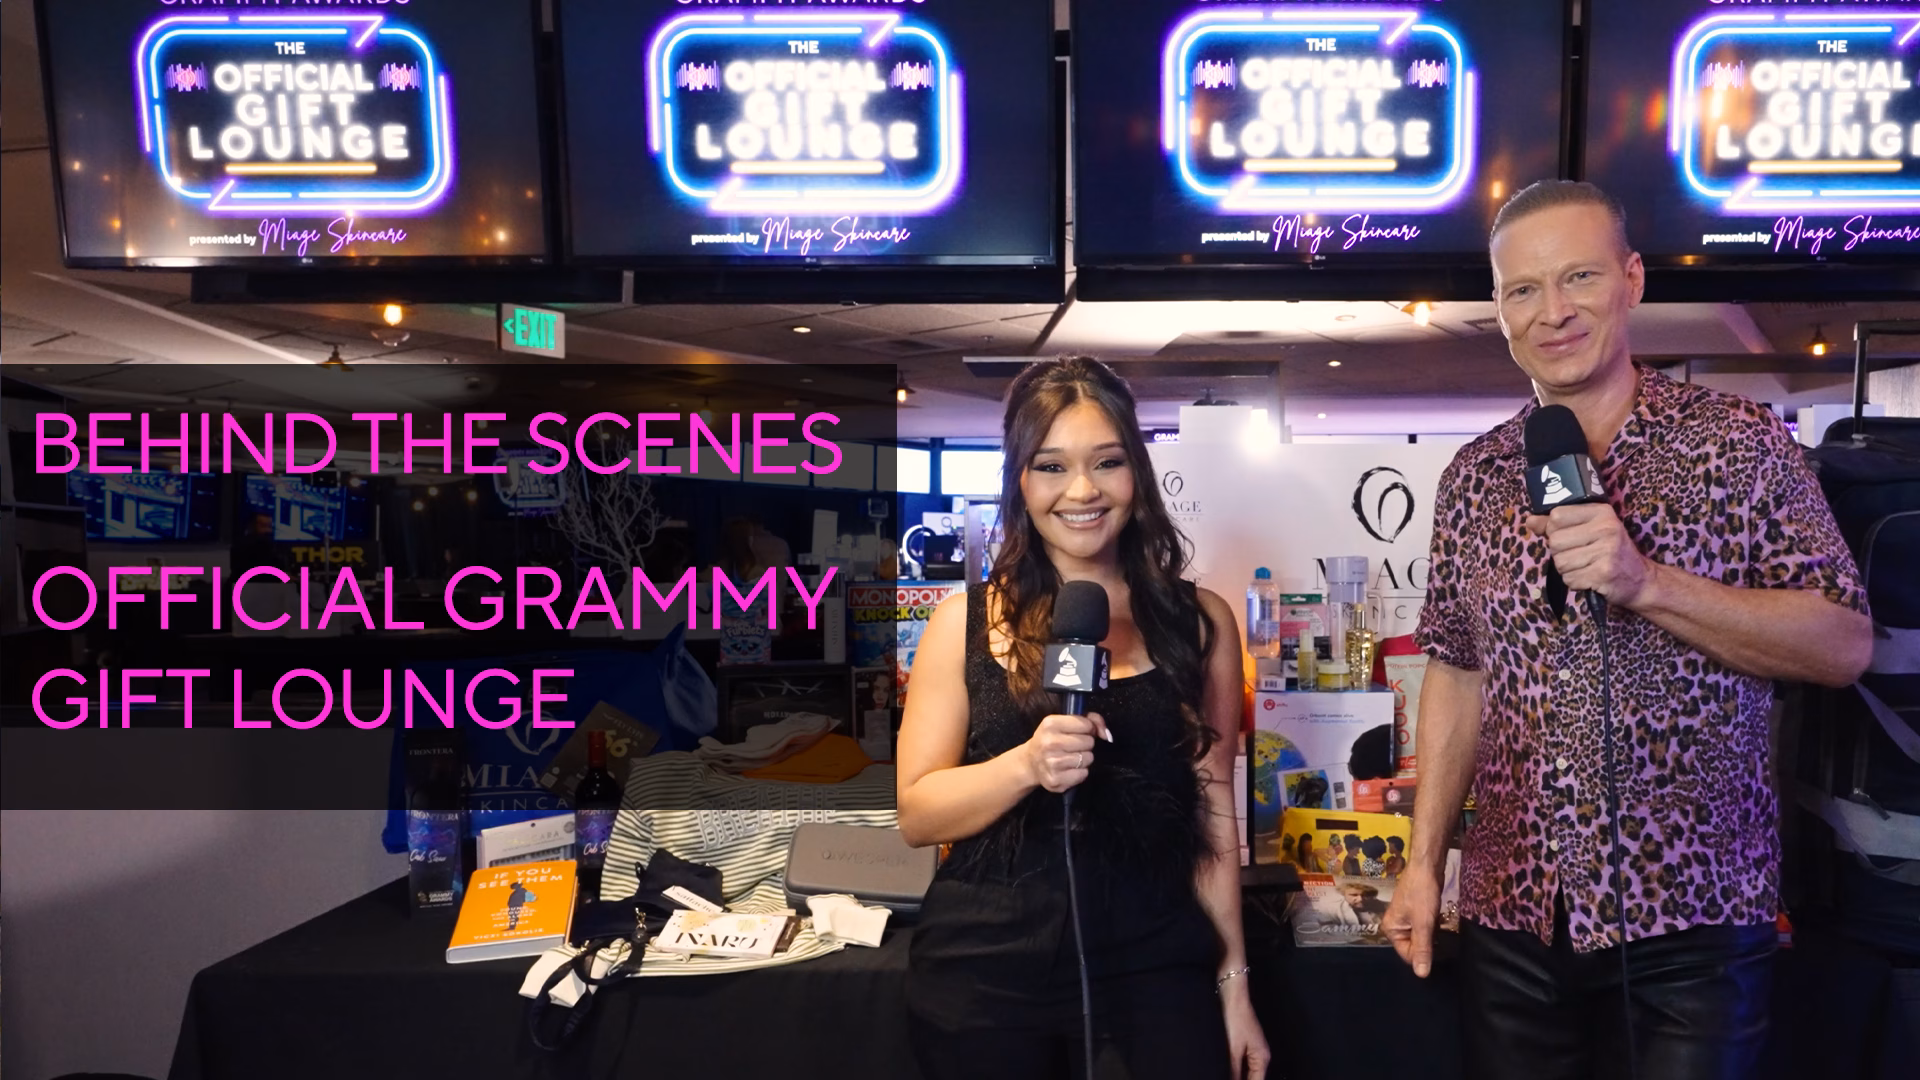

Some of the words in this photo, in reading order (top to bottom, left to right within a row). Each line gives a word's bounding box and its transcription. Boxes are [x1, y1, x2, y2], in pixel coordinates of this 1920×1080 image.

[275, 42, 305, 54] THE
[788, 41, 819, 54] THE
[1306, 38, 1336, 51] THE
[1818, 40, 1847, 52] THE
[214, 63, 373, 92] OFFICIAL
[725, 60, 886, 93] OFFICIAL
[1241, 59, 1400, 89] OFFICIAL
[1751, 61, 1910, 90] OFFICIAL
[236, 94, 355, 126] GIFT
[744, 92, 868, 126] GIFT
[1260, 90, 1382, 122] GIFT
[1768, 91, 1890, 124] GIFT
[189, 127, 409, 158] LOUNGE
[695, 124, 917, 159] LOUNGE
[1210, 121, 1430, 157] LOUNGE
[189, 234, 240, 246] presented
[243, 234, 256, 247] by
[258, 218, 320, 256] Miage
[327, 219, 407, 254] Skincare
[692, 233, 744, 245] presented
[746, 233, 759, 245] by
[762, 217, 824, 255] Miage
[831, 216, 910, 253] Skincare
[1202, 231, 1254, 243] presented
[1256, 231, 1269, 244] by
[1272, 216, 1334, 254] Miage
[1342, 214, 1420, 250] Skincare
[1703, 232, 1755, 245] presented
[1757, 232, 1771, 245] by
[1773, 216, 1836, 255] Miage
[514, 308, 557, 350] EXIT
[291, 546, 364, 564] THOR
[854, 606, 911, 621] KNOCK
[478, 880, 509, 889] SEE
[516, 875, 562, 884] THEM
[516, 867, 552, 876] YOU
